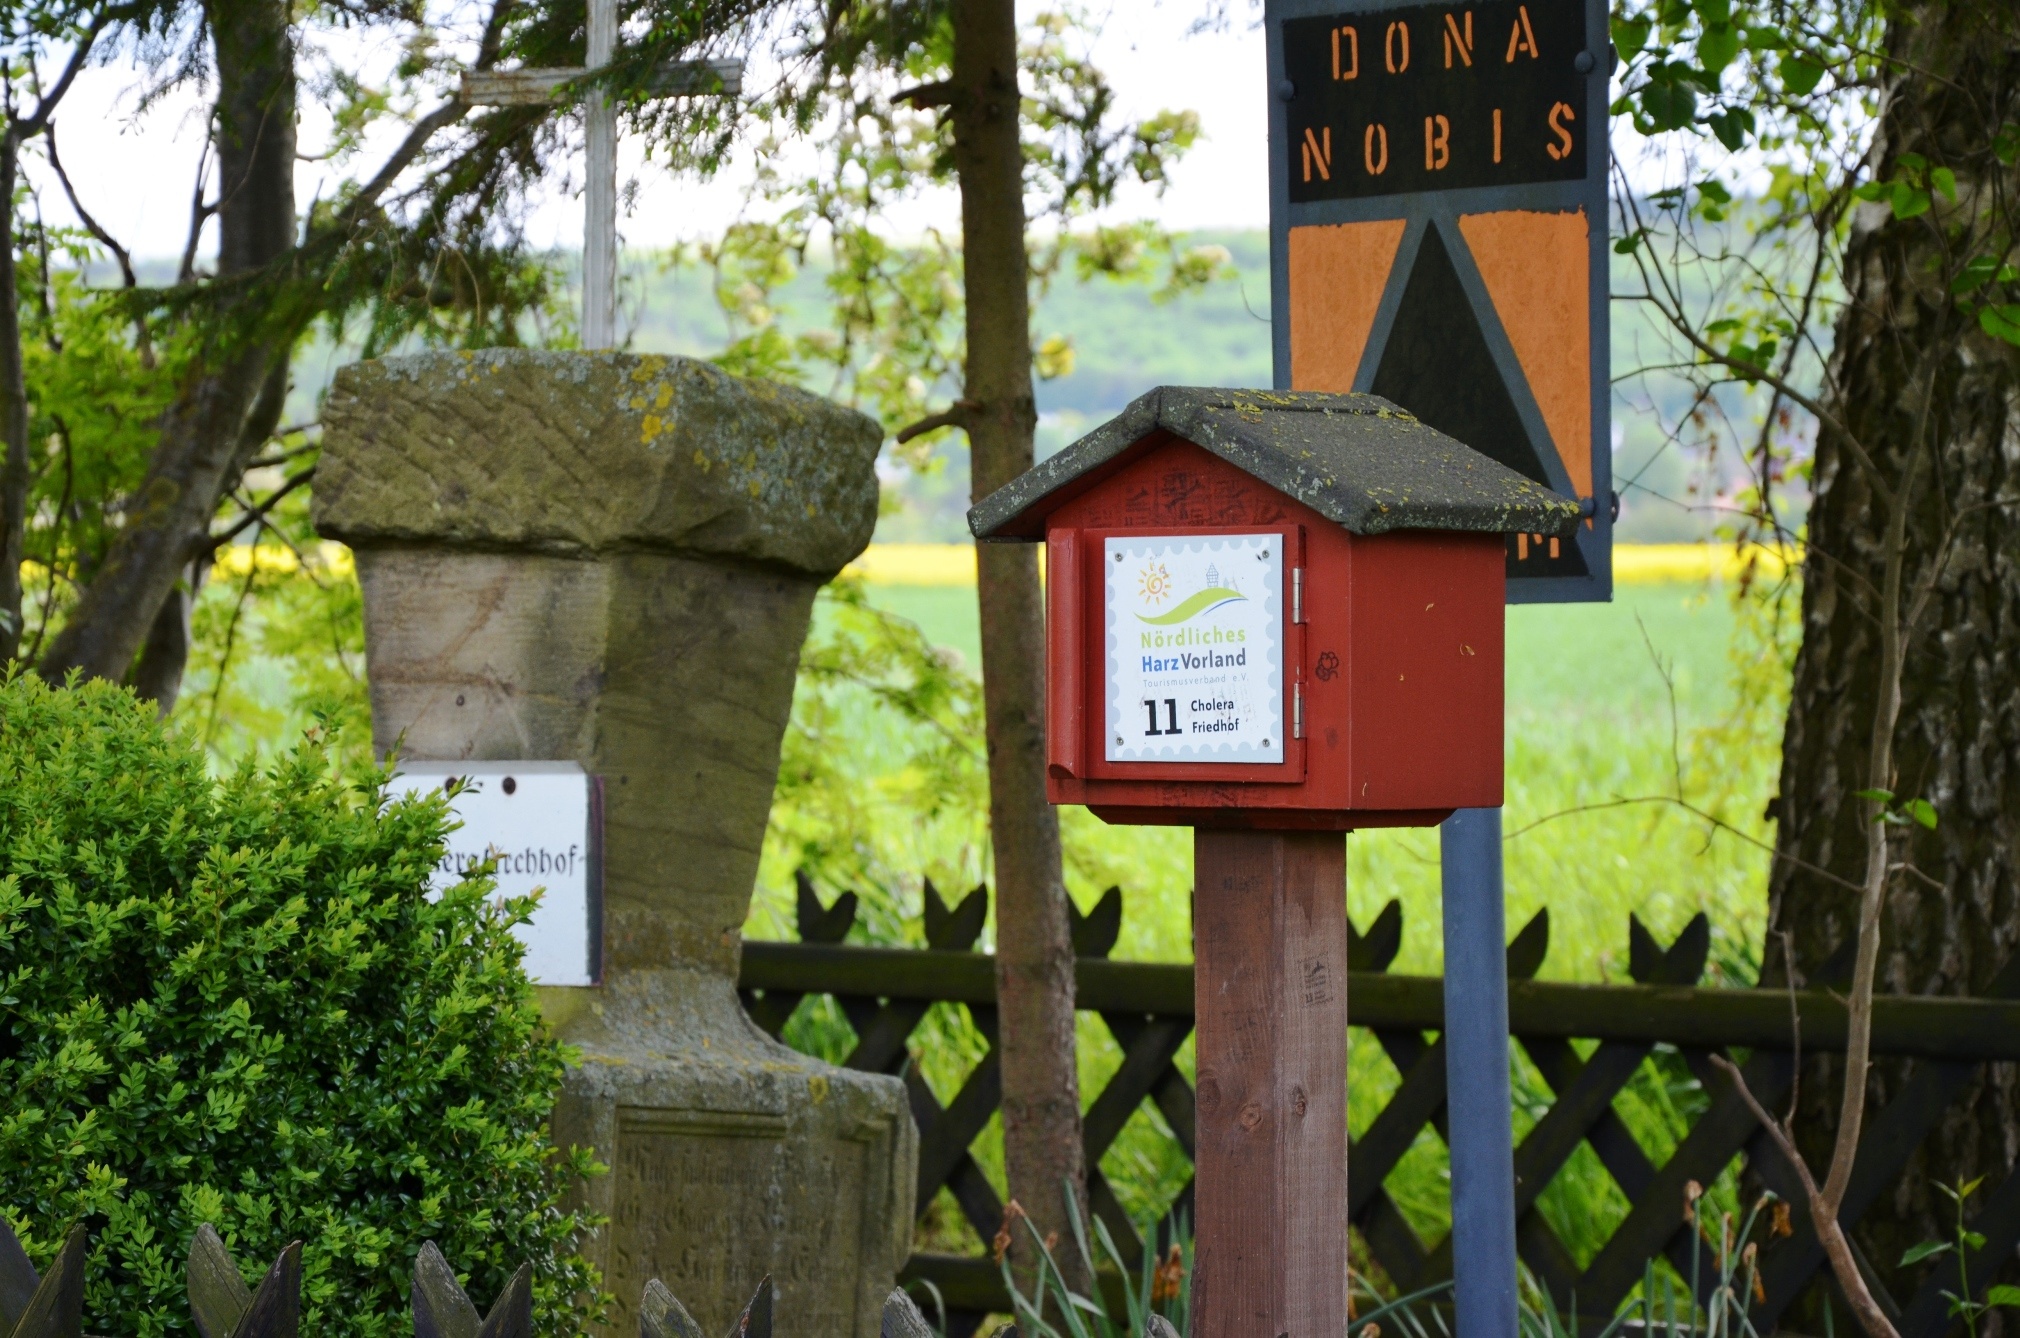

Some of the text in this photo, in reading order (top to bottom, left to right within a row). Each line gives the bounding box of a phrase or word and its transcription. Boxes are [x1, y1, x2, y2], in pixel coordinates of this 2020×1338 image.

[1331, 5, 1539, 81] DONA
[1302, 100, 1575, 182] NOBIS
[1140, 625, 1246, 649] Nördliches
[1143, 674, 1226, 688] Tourismusverband
[1190, 697, 1235, 712] Cholera
[1144, 698, 1183, 736] 11
[1192, 717, 1240, 734] Friedhof
